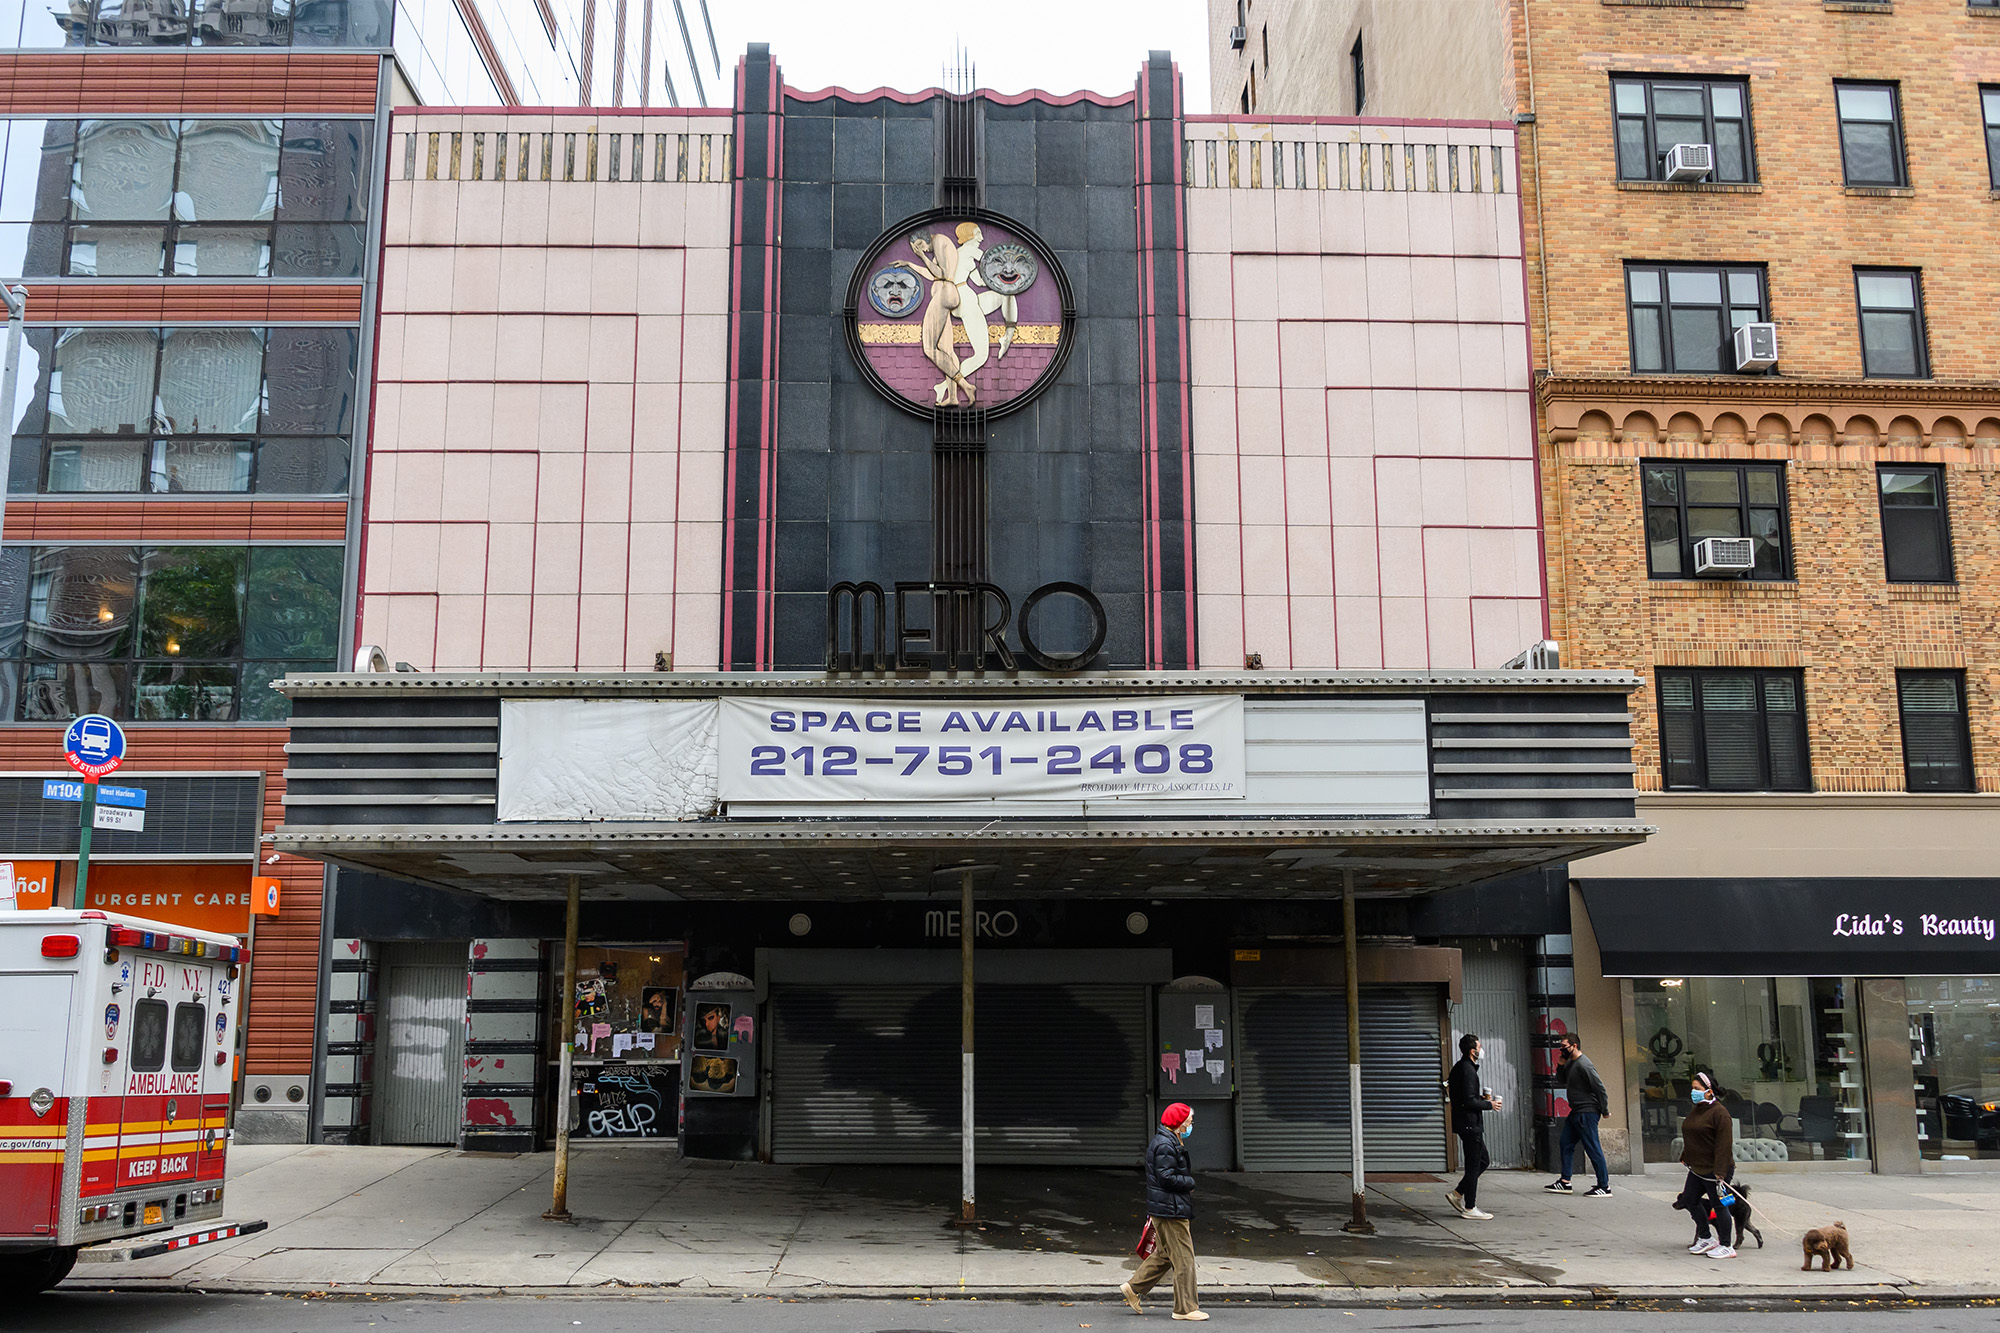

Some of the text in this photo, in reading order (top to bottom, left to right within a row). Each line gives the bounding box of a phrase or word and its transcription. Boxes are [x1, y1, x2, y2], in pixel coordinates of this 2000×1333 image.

[828, 581, 1107, 671] METRO
[770, 709, 1194, 733] SPACE AVAILABLE
[69, 753, 119, 774] NO STANDING
[750, 743, 1213, 776] 212-751-2408
[46, 783, 82, 798] M104
[100, 787, 136, 798] West Harlem
[1131, 782, 1165, 792] METRO
[99, 808, 127, 818] Broadway
[95, 893, 250, 906] URGENT CARE
[925, 910, 1018, 937] MERO
[1832, 913, 1995, 941] Lida's Beauty
[143, 962, 203, 992] F.D. N.Y.
[217, 979, 232, 995] 421
[128, 1073, 199, 1095] AMBULANCE
[0, 1140, 52, 1150] c.gov/fdny
[128, 1156, 189, 1178] KEEP BACK
